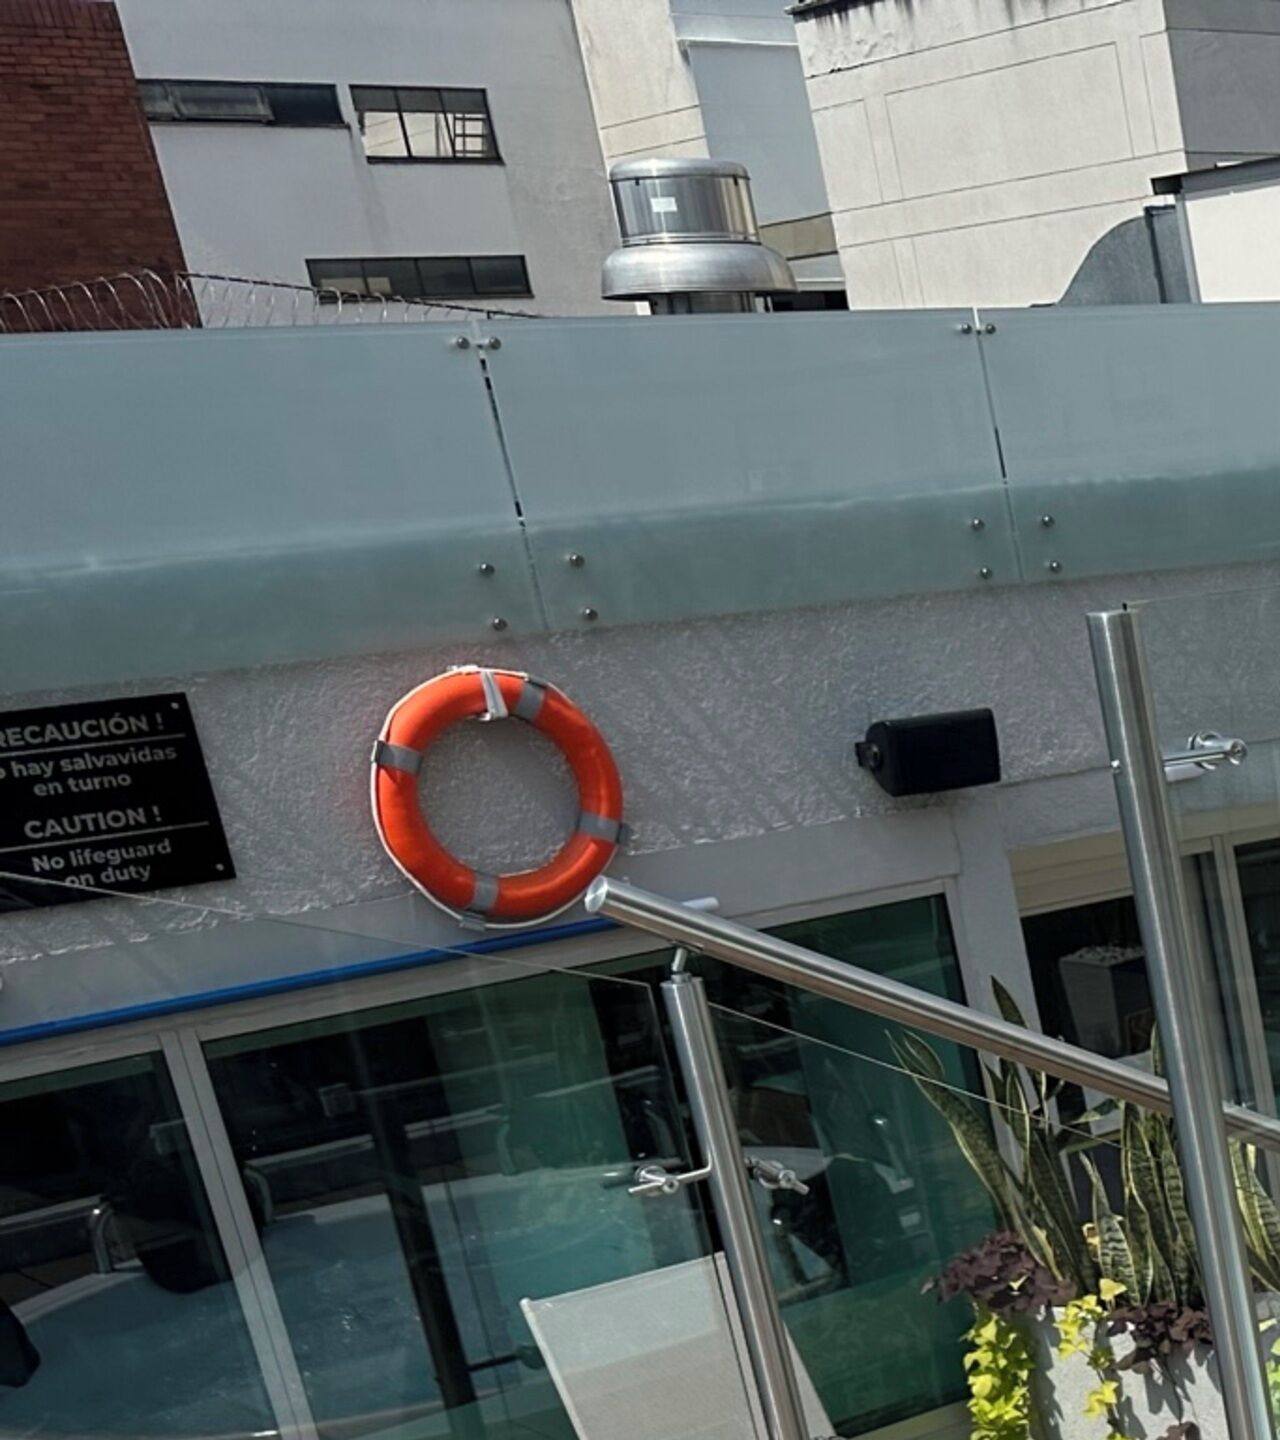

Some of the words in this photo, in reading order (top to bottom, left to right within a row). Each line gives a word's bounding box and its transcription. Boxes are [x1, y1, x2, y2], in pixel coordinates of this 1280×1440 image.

[155, 711, 164, 730] !
[10, 760, 54, 778] hay
[60, 746, 177, 772] salvavidas
[33, 781, 64, 797] en
[67, 774, 132, 792] turno
[24, 807, 147, 839] CAUTION
[152, 805, 162, 822] !
[31, 854, 65, 872] No
[69, 837, 172, 866] lifeguard
[64, 873, 95, 888] on
[100, 864, 151, 883] duty
